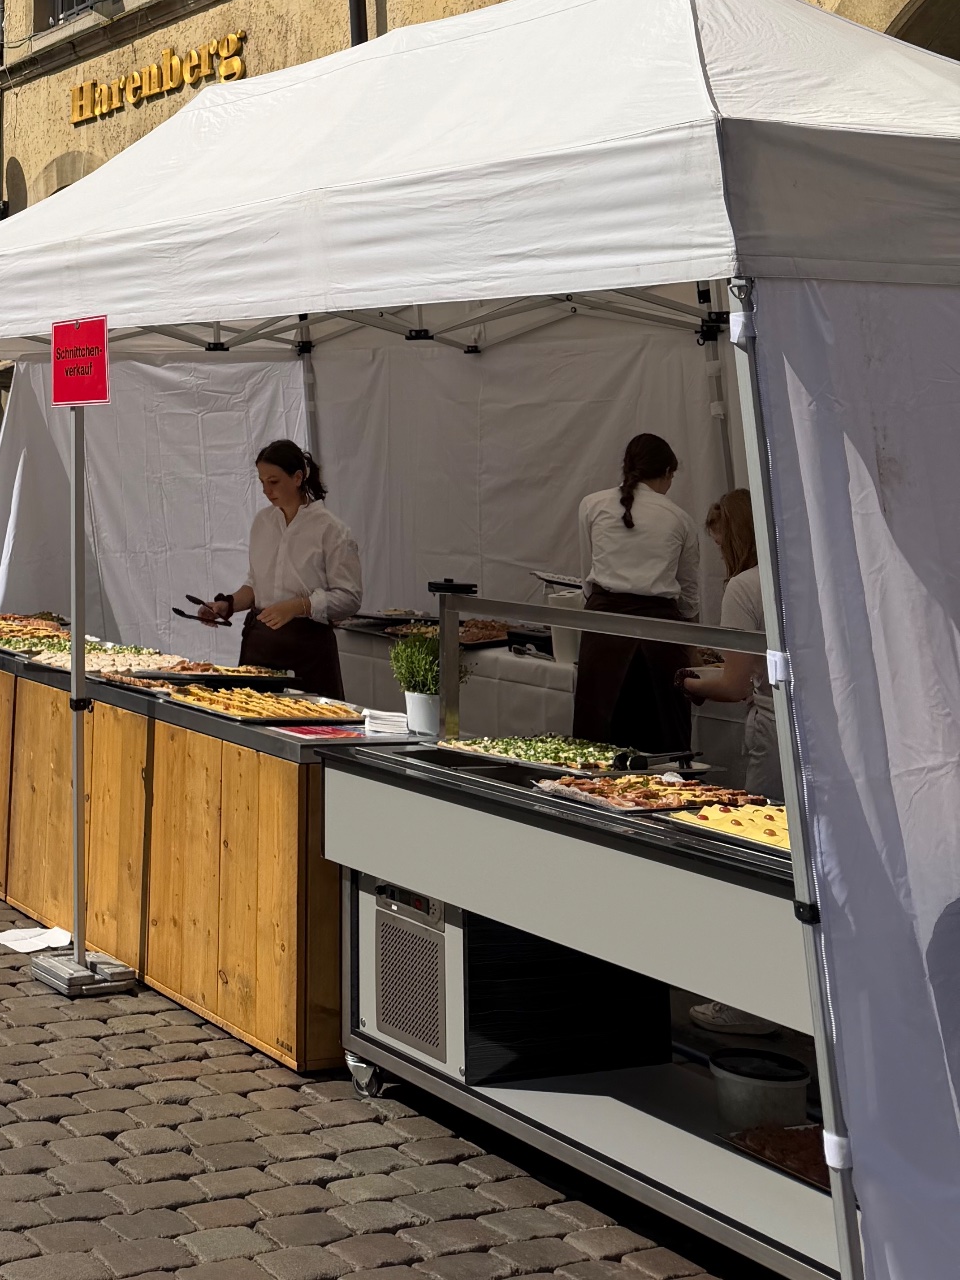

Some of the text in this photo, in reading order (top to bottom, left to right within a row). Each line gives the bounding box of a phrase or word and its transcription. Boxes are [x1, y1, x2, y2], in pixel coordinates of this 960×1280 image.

[69, 29, 246, 124] Harenberg
[56, 344, 102, 360] Schnittchen-
[64, 362, 93, 377] verkauf
